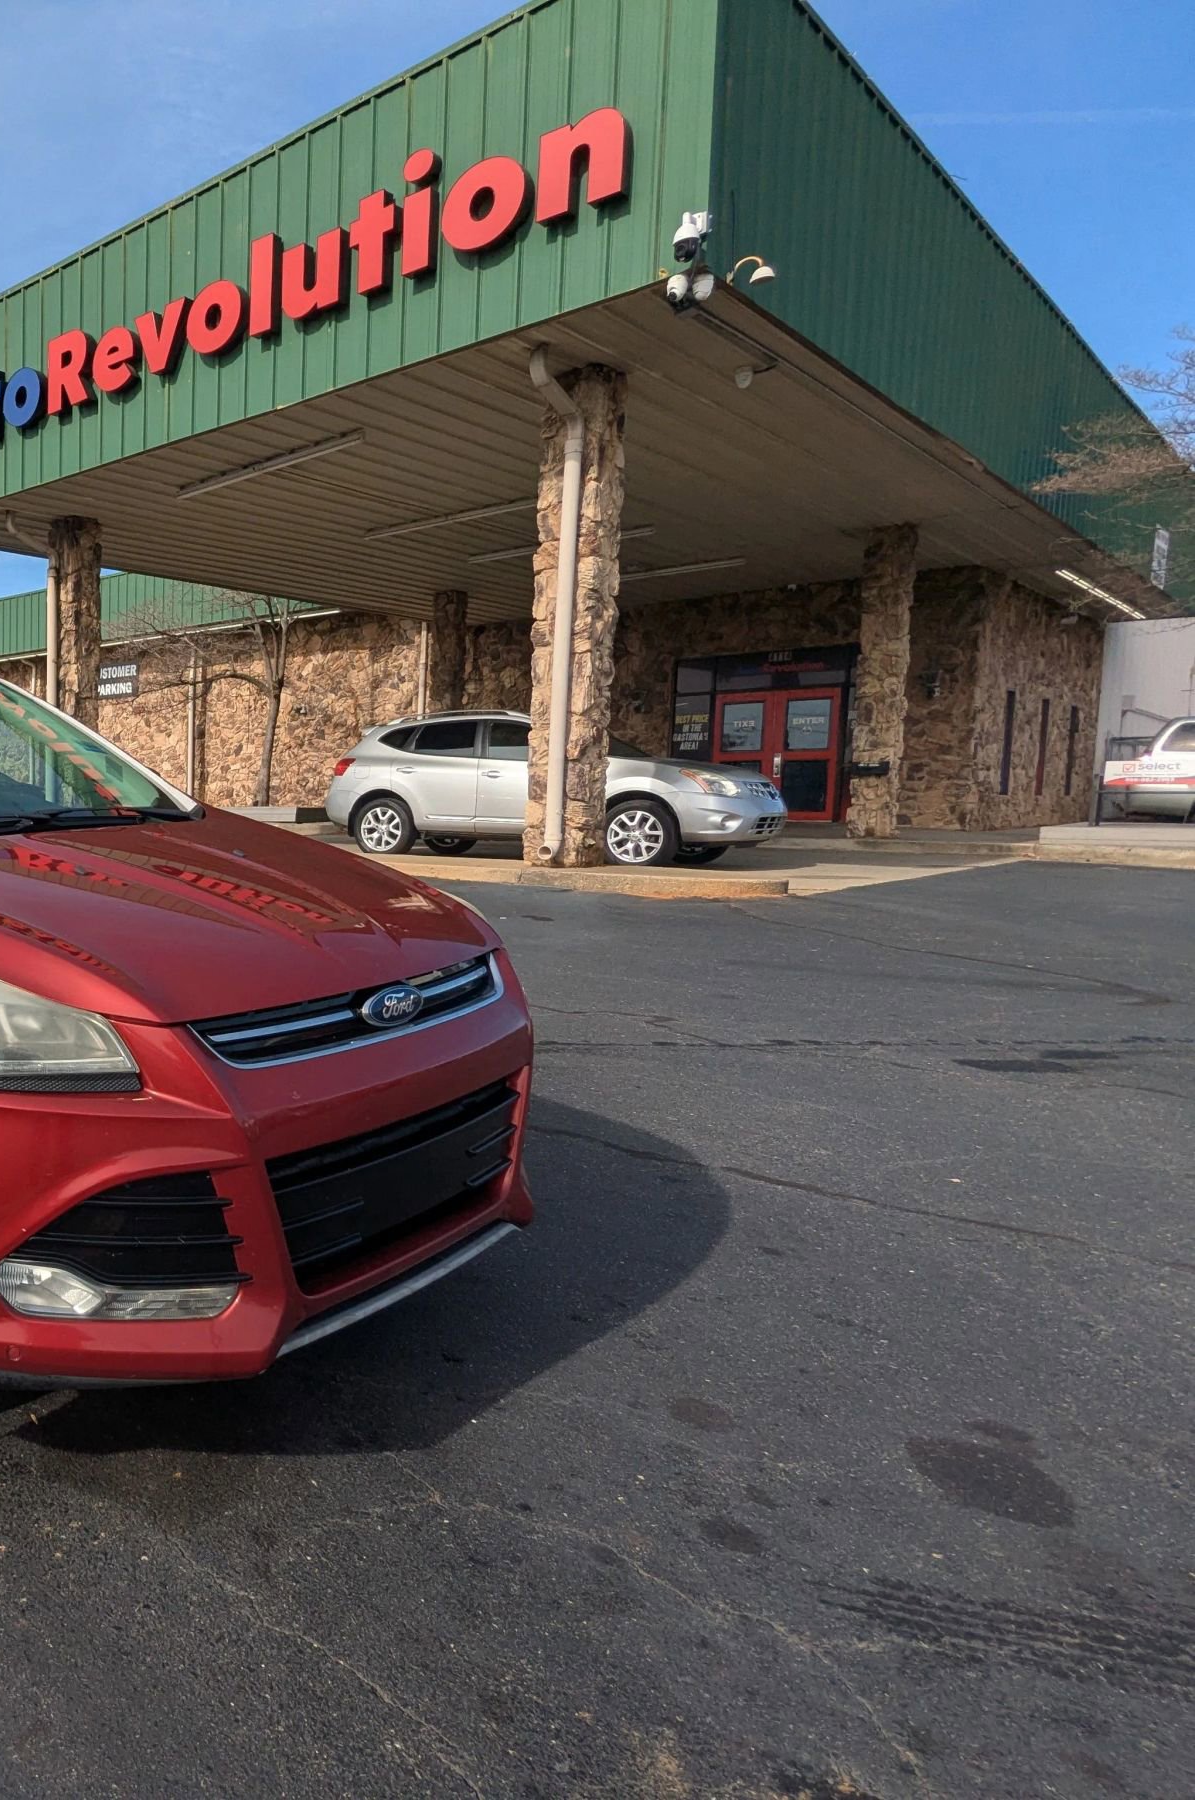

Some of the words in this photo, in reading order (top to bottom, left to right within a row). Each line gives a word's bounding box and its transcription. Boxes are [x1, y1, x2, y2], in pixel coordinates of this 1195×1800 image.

[100, 664, 137, 680] STOMER
[692, 714, 709, 723] PRICE
[792, 717, 824, 725] ENTER
[691, 723, 702, 732] THE
[1138, 762, 1181, 771] select
[382, 992, 414, 1019] Ford
